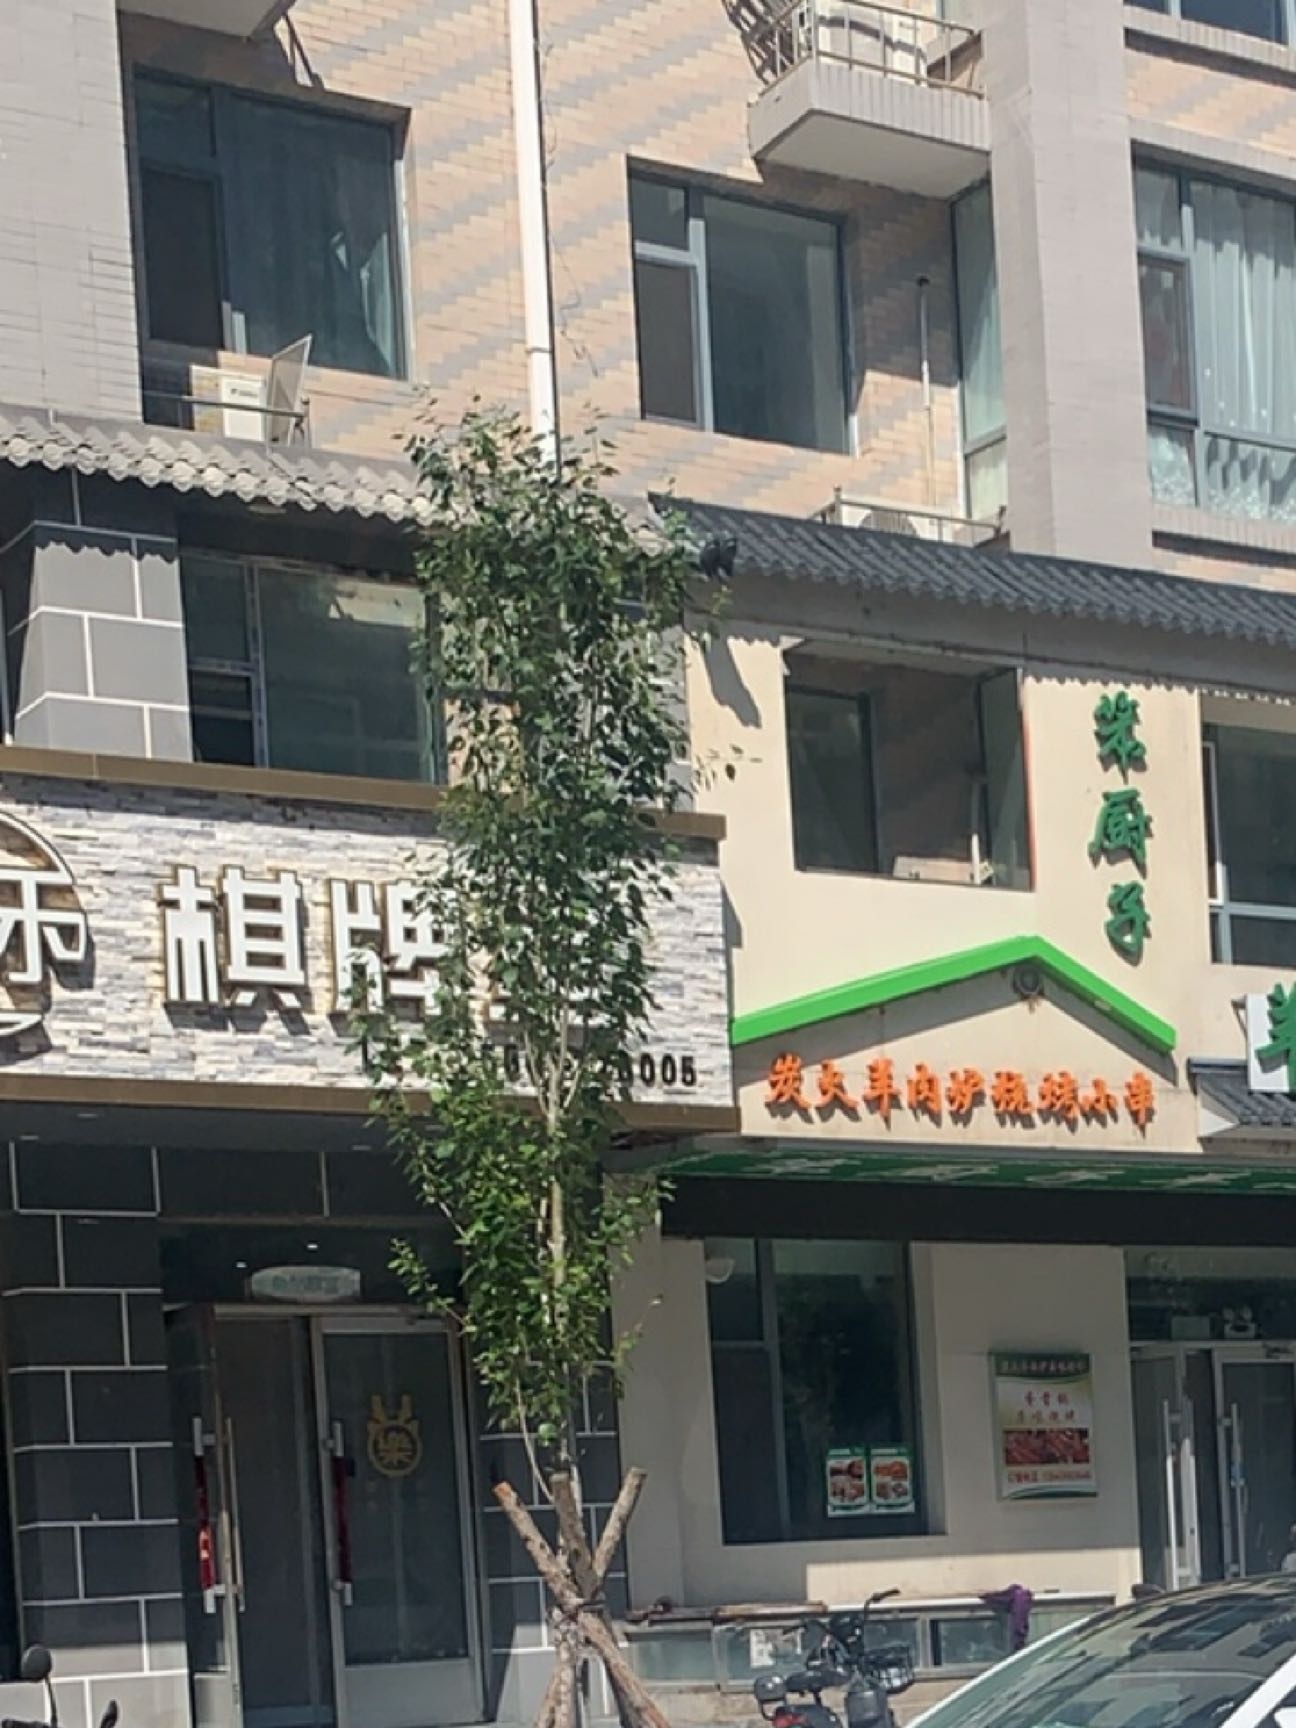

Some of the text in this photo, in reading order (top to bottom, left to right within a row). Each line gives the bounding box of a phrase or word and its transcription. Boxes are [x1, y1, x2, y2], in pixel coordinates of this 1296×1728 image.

[1087, 690, 1152, 966] 笨厨子
[158, 864, 612, 1028] 棋牌
